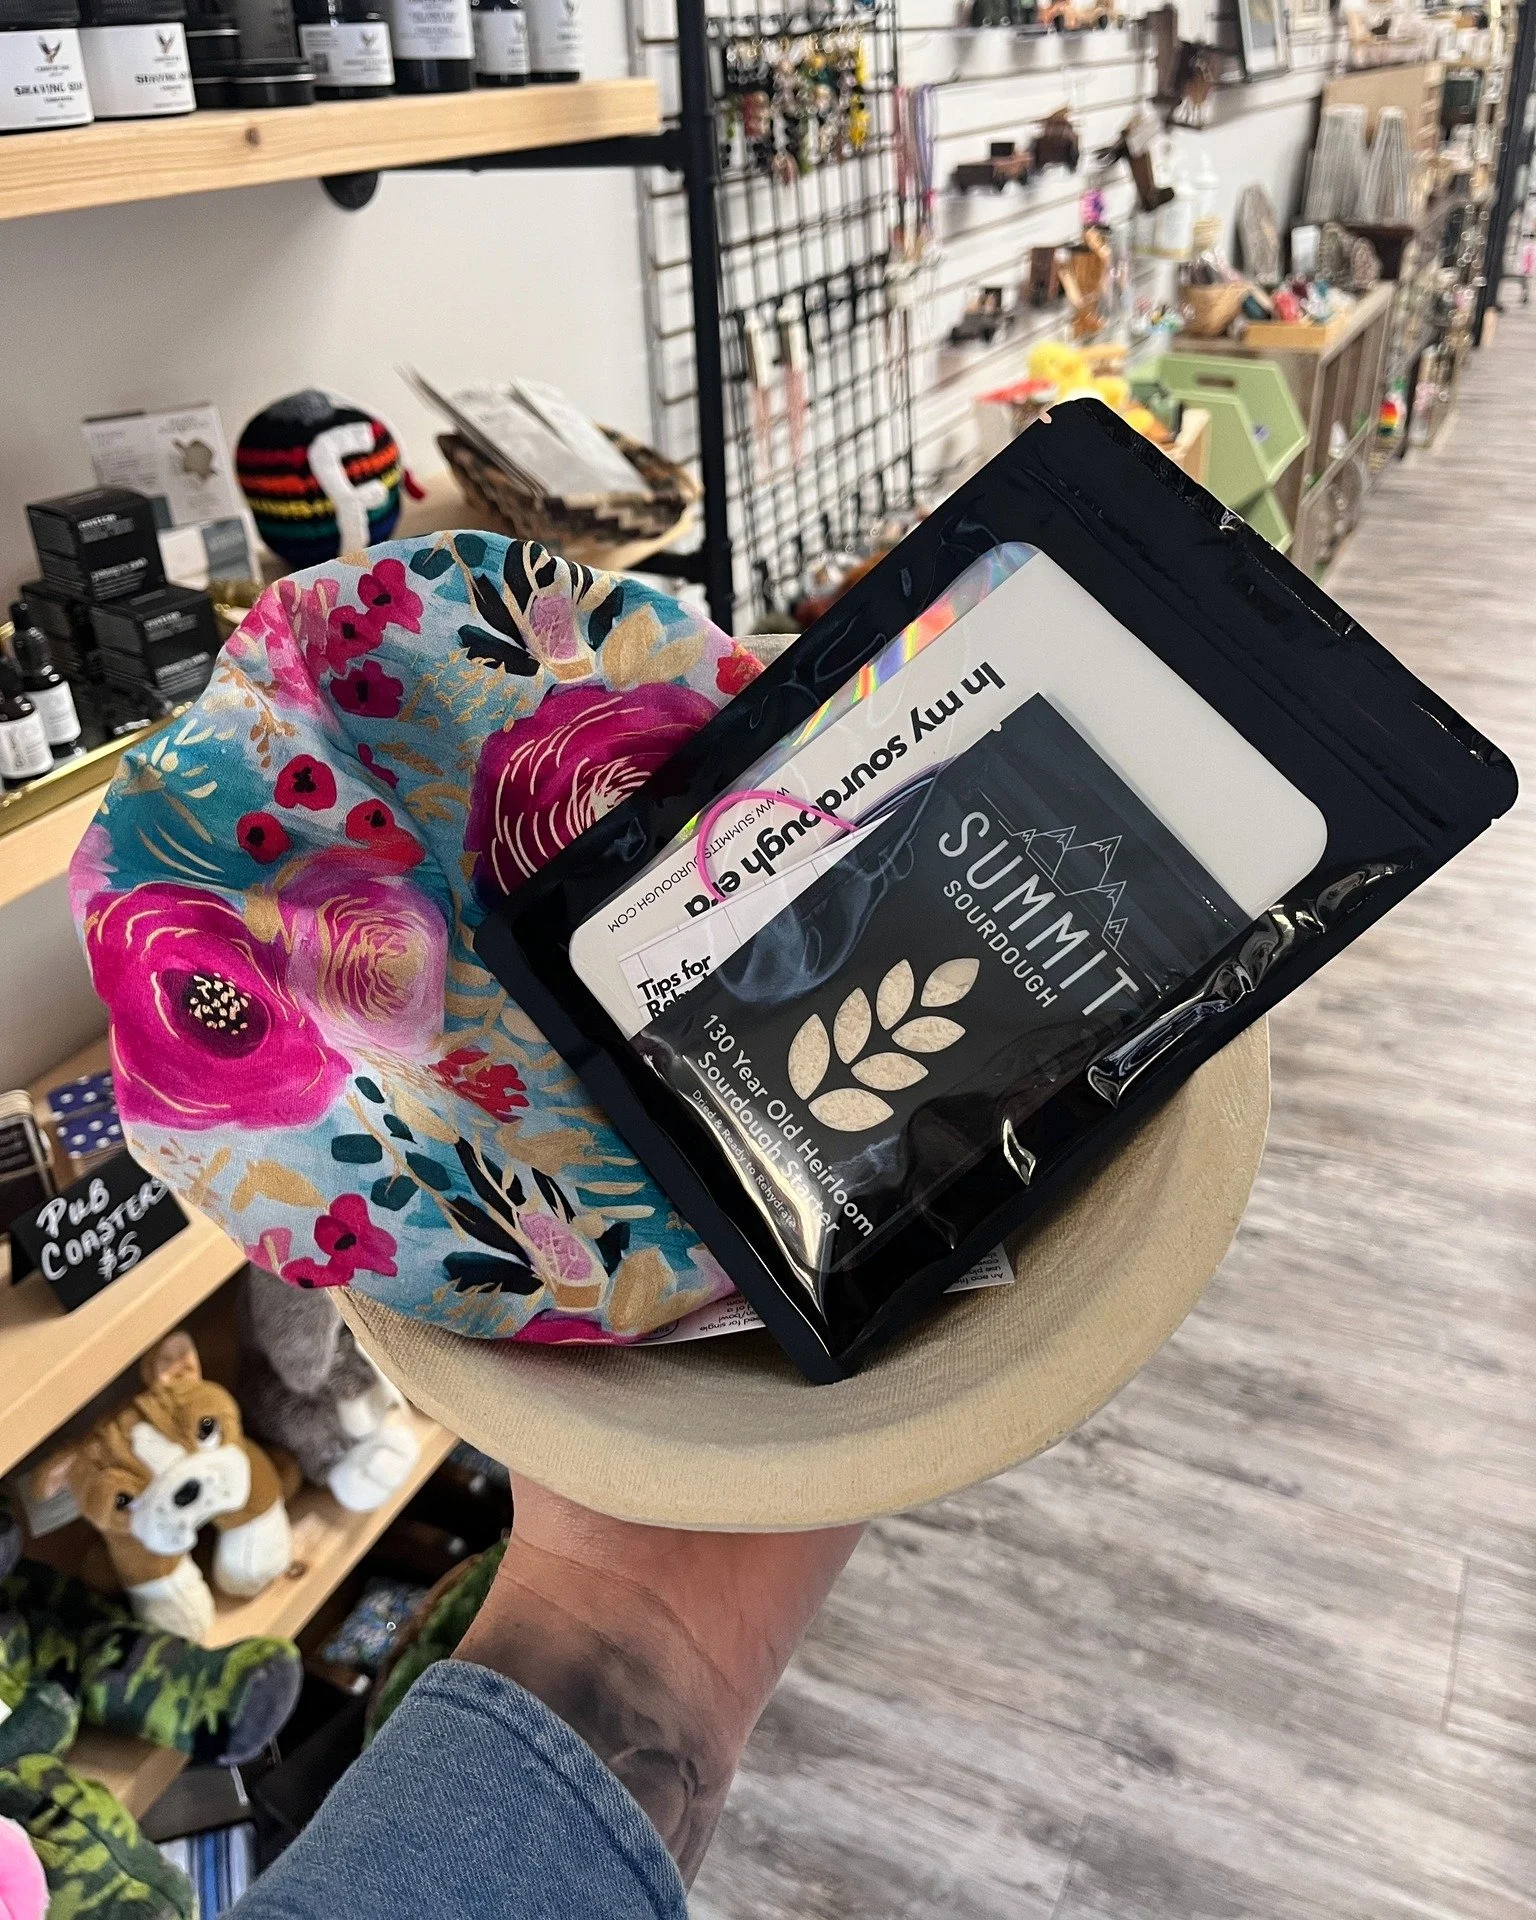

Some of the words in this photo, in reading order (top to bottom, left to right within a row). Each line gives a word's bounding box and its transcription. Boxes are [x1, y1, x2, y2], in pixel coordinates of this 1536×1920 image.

[910, 690, 964, 743] my
[960, 661, 1006, 690] In
[607, 786, 790, 933] WWW.SUMMITSURDOUGH.COM
[740, 734, 908, 877] sourdough
[637, 973, 681, 1000] Tips
[681, 955, 711, 980] for
[938, 811, 1140, 1016] SUMMIT
[942, 880, 1058, 1008] SOURDOUGH
[692, 1089, 717, 1121] Dried
[714, 1118, 723, 1130] &
[721, 1128, 749, 1163] Ready
[745, 1160, 756, 1175] to
[755, 1174, 797, 1229] Rehydrate
[698, 1051, 782, 1161] Sourdough
[780, 1160, 840, 1234] Starter
[703, 1014, 735, 1053] 130
[732, 1049, 768, 1098] Year
[766, 1099, 804, 1141] Old
[796, 1138, 874, 1237] Heirloom
[98, 1230, 142, 1281] $5
[700, 1321, 726, 1332] single
